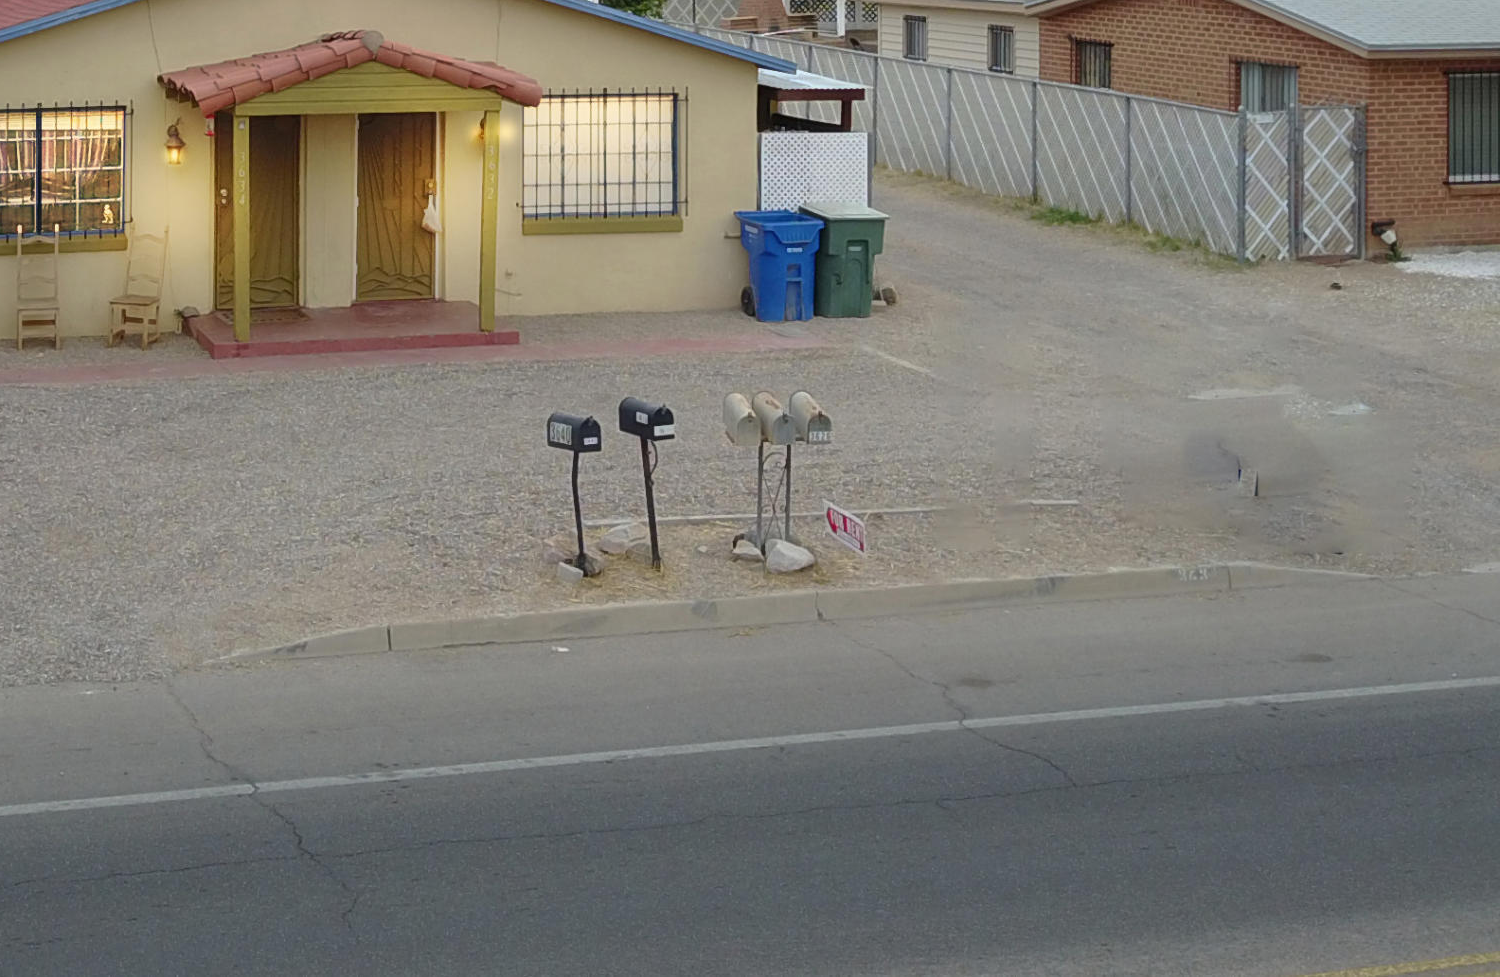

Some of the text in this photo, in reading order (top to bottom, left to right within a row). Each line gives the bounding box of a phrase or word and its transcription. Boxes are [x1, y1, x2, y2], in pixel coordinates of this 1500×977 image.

[550, 422, 572, 445] 3640
[829, 508, 845, 532] FOR
[846, 517, 864, 544] RENT
